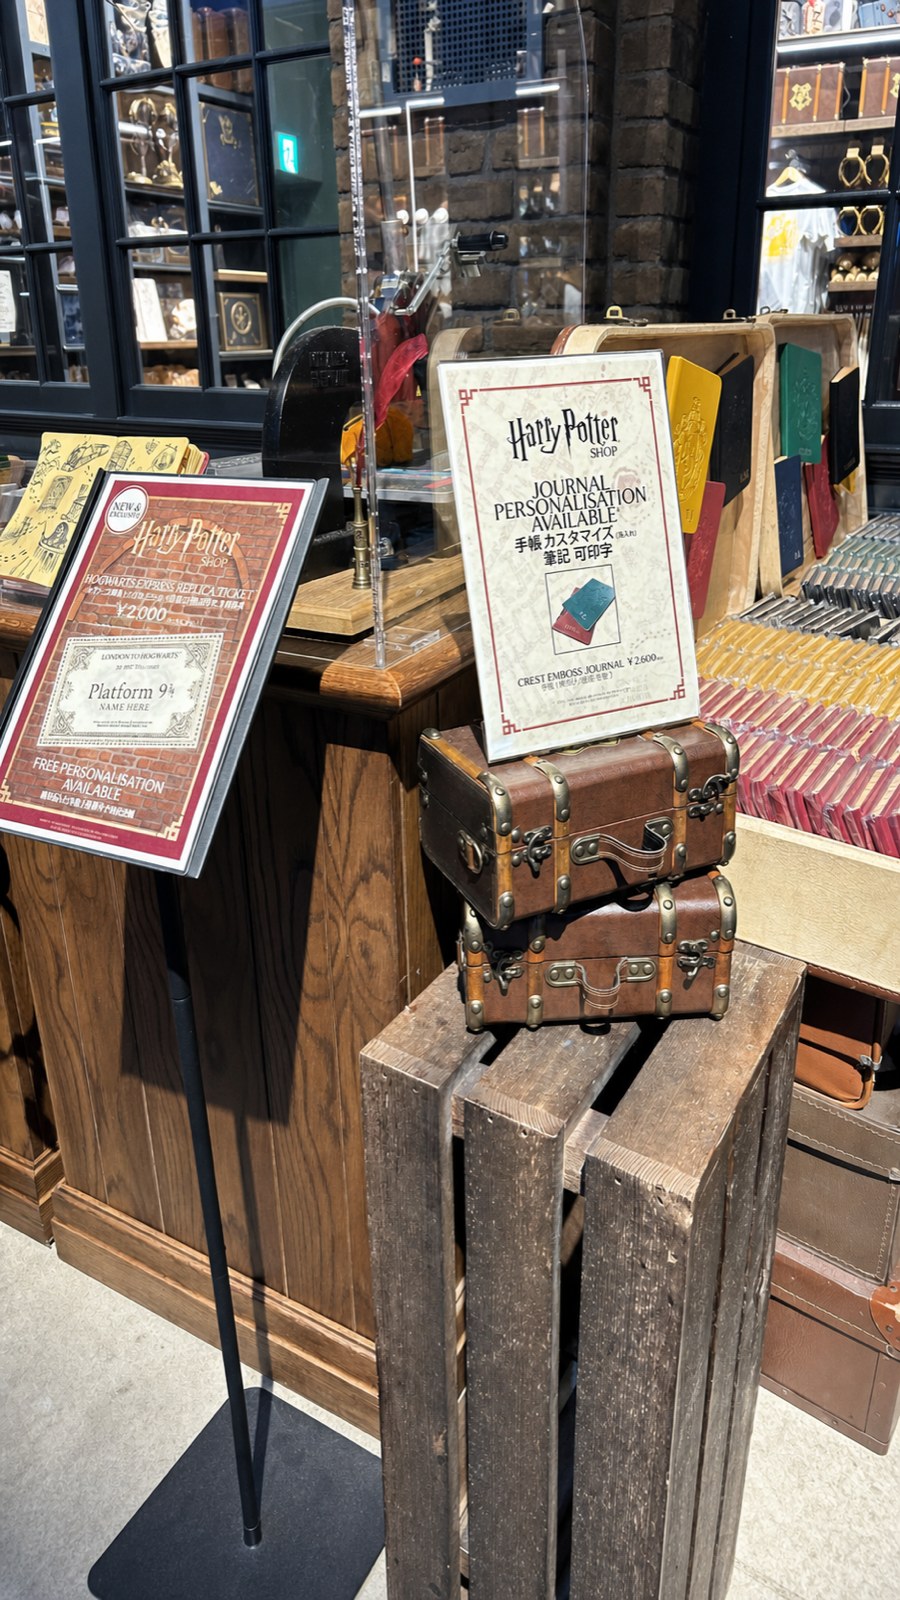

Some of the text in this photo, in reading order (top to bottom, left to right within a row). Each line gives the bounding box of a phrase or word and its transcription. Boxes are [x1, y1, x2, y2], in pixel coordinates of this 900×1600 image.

[507, 408, 620, 461] Harry Potter
[590, 446, 618, 458] SHOP
[532, 475, 610, 499] JOURNAL
[113, 502, 134, 511] NEW
[494, 486, 647, 520] PERSONALISATION
[532, 507, 618, 532] AVAILABLE
[131, 518, 240, 560] Harry Potter
[515, 535, 542, 553] 手帳
[544, 525, 614, 550] カスタマイズ
[200, 557, 228, 567] SHOP
[573, 542, 613, 562] 可印字
[84, 573, 137, 588] HOGWARTS
[176, 582, 218, 596] REPLICA
[217, 586, 254, 600] TICKET
[131, 652, 140, 660] TO
[140, 651, 179, 660] HOGWARTS
[517, 673, 545, 687] CREST
[547, 667, 583, 682] EMBOSS
[584, 659, 625, 674] JOURNAL
[88, 682, 153, 700] Platform
[99, 702, 150, 711] NAME HERE
[33, 757, 165, 794] FREE PERSONALISATION
[61, 778, 122, 801] AVAILABLE
